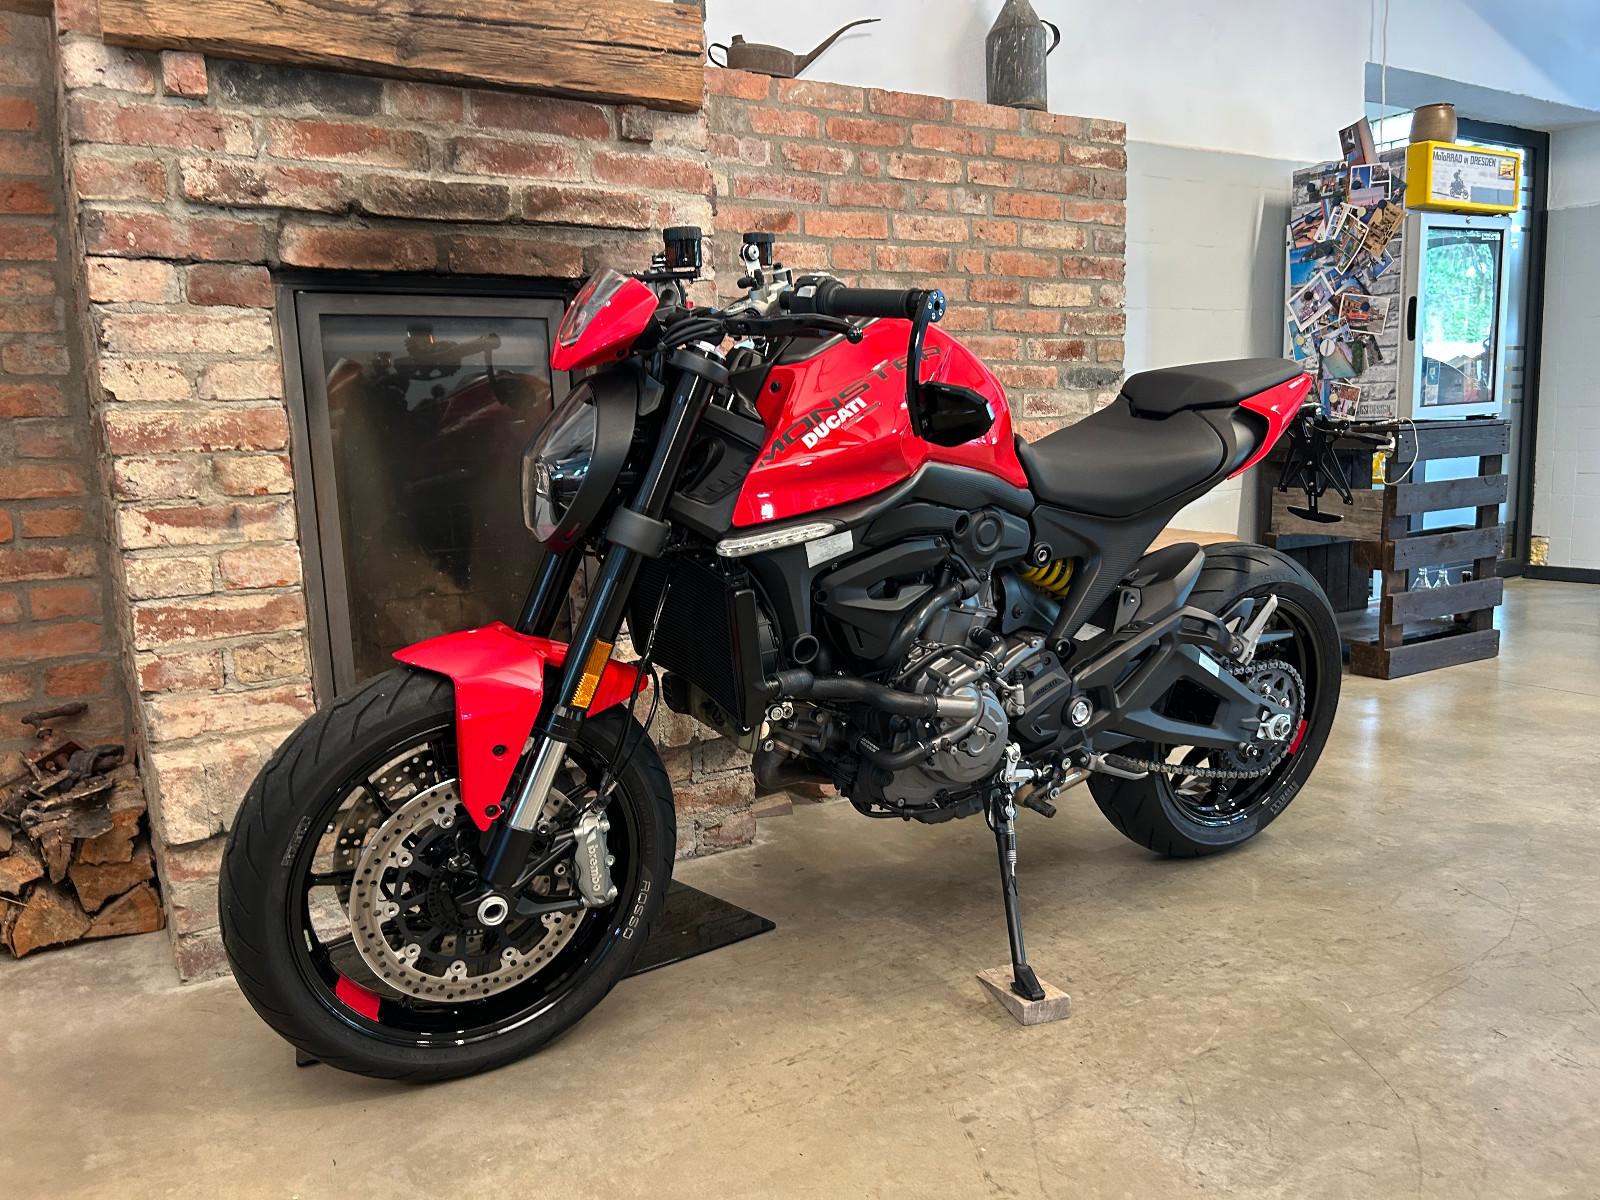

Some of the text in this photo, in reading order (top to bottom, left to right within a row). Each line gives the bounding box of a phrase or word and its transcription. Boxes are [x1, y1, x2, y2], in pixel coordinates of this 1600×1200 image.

[1470, 155, 1496, 167] DRESDEN
[801, 397, 867, 449] DUCATI
[587, 844, 602, 892] brembo
[623, 880, 651, 940] ROSSO
